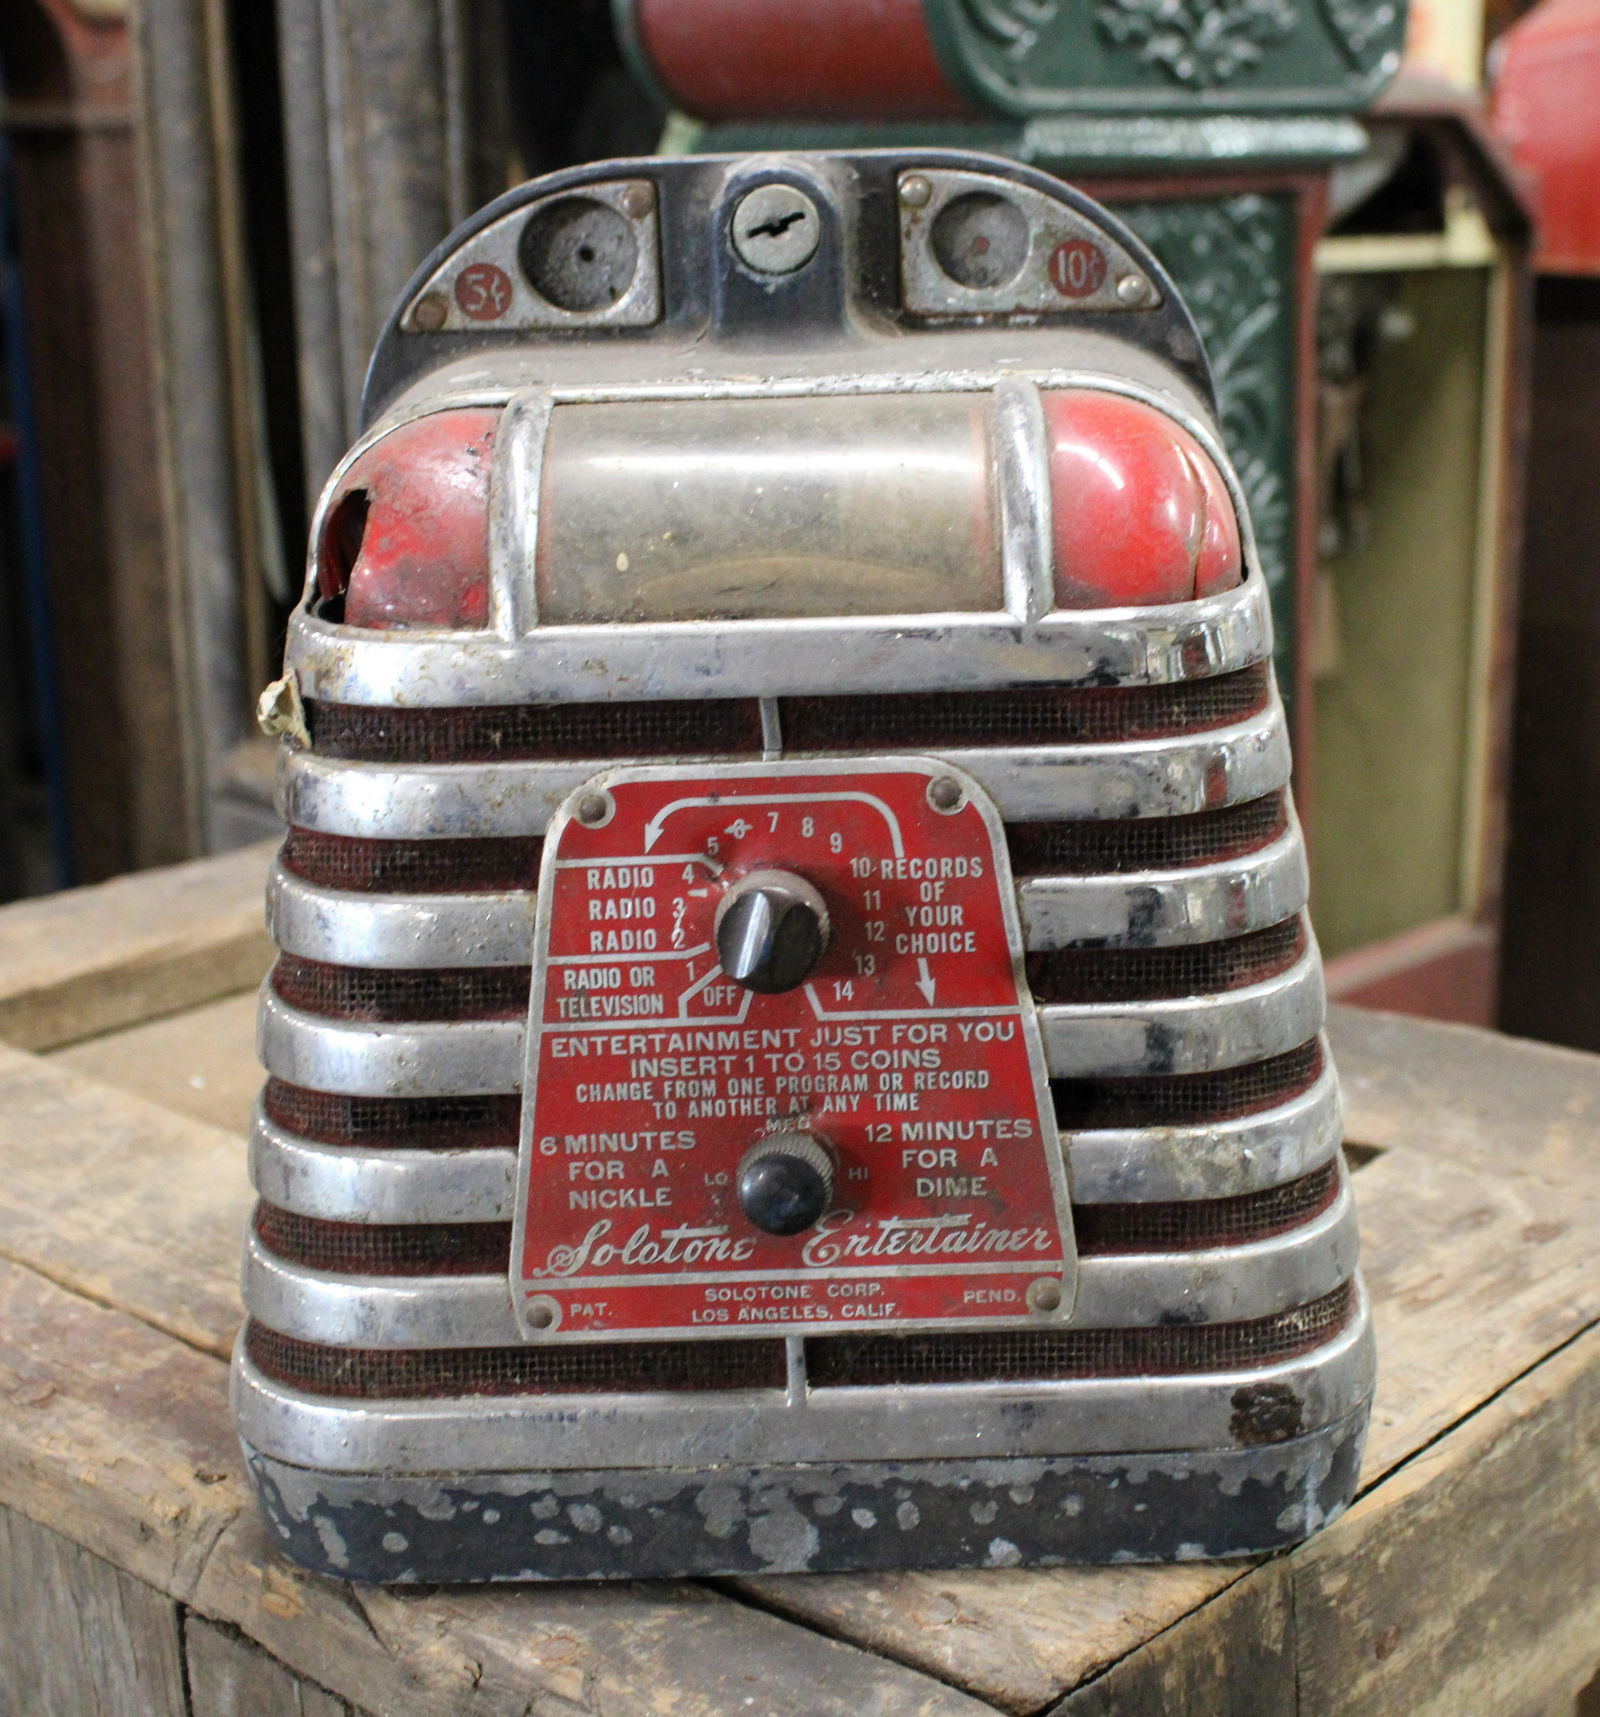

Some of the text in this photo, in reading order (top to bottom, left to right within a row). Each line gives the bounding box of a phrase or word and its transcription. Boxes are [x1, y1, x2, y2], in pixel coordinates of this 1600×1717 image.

[733, 819, 746, 839] 6
[767, 812, 780, 832] 7
[801, 818, 814, 837] 8
[707, 837, 719, 855] 5
[830, 833, 843, 853] 9
[587, 863, 696, 889] RADIO 4
[880, 857, 983, 879] RECORDS
[864, 891, 881, 910] 11
[920, 882, 944, 902] OF
[588, 897, 685, 920] RADIO 3
[905, 907, 964, 927] YOUR
[590, 928, 686, 951] RADIO 2
[865, 922, 885, 942] 12
[896, 933, 977, 954] CHOICE
[686, 963, 695, 981] 1
[855, 955, 875, 975] 13
[564, 967, 655, 989] RADIO OR
[703, 986, 736, 1006] OFF
[833, 981, 854, 1001] 14
[557, 995, 664, 1017] TELEVISION
[551, 1022, 1015, 1059] ENTERTAINMENT JUST FOR YOU
[631, 1049, 942, 1078] INSERT 1 TO 15 COINS
[576, 1070, 990, 1103] CHANGE FROM ONE PROGRAM OR RECORD
[653, 1093, 920, 1119] TO ANOTHER AT ANY TIME
[865, 1119, 1033, 1143] 12 MINUTES
[539, 1131, 696, 1156] 6 MINUTES
[902, 1148, 998, 1168] FOR A
[568, 1159, 670, 1182] FOR A
[705, 1173, 728, 1187] LO
[848, 1168, 869, 1181] HI
[916, 1176, 988, 1198] DIME
[569, 1188, 672, 1209] NICKLE
[533, 1210, 1052, 1278] Solotone Entertainer
[705, 1282, 885, 1301] SOLOTONE CORP.
[963, 1289, 1022, 1304] PEND.
[570, 1302, 613, 1317] PAT.
[692, 1302, 901, 1323] LOS ANGELES, CALIF.
